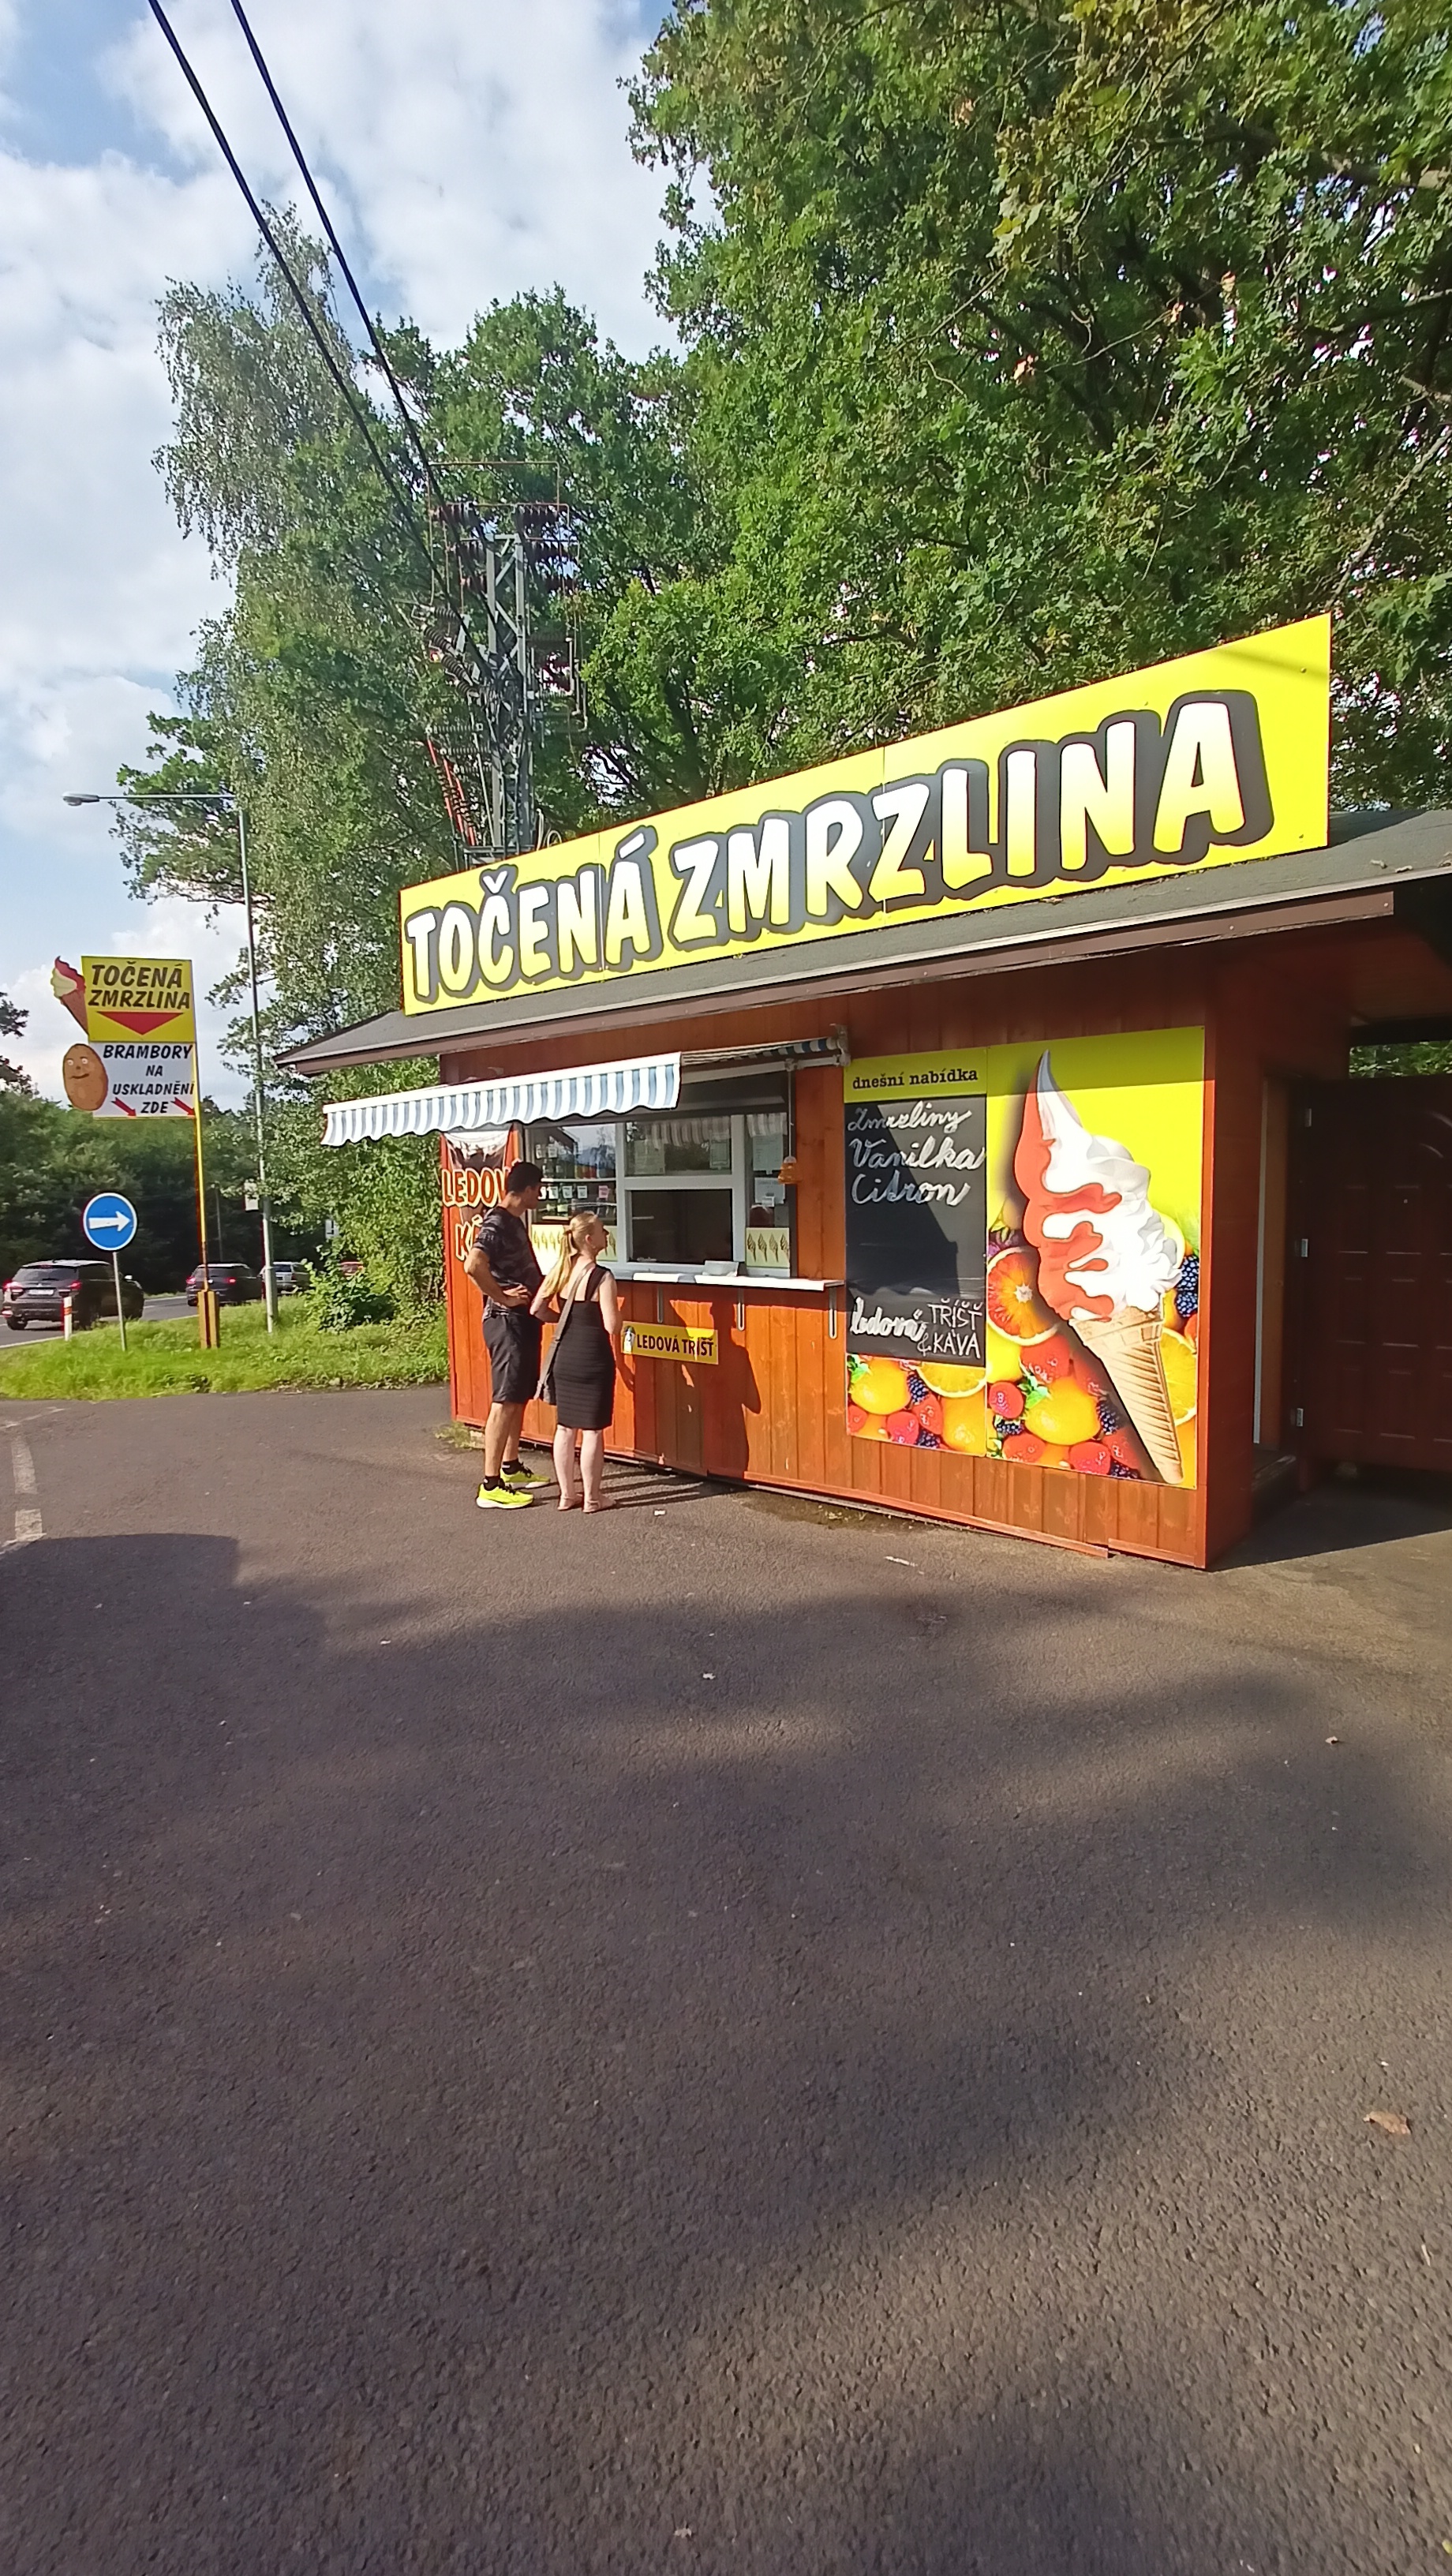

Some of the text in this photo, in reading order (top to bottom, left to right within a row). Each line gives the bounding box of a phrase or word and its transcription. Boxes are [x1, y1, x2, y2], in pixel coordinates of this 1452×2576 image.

[405, 691, 1274, 1004] TOČENÁ ZMRZLINA
[92, 960, 183, 988] TOČENÁ
[88, 989, 190, 1009] ZMRZLINA
[103, 1044, 193, 1059] BRAMBORY
[145, 1065, 163, 1076] NA
[852, 1068, 978, 1090] dnešní nabídka
[140, 1101, 169, 1114] ZDE
[849, 1134, 986, 1170] Vanilka
[442, 1164, 511, 1208] LEDOV
[637, 1334, 680, 1353] LEDOVÁ
